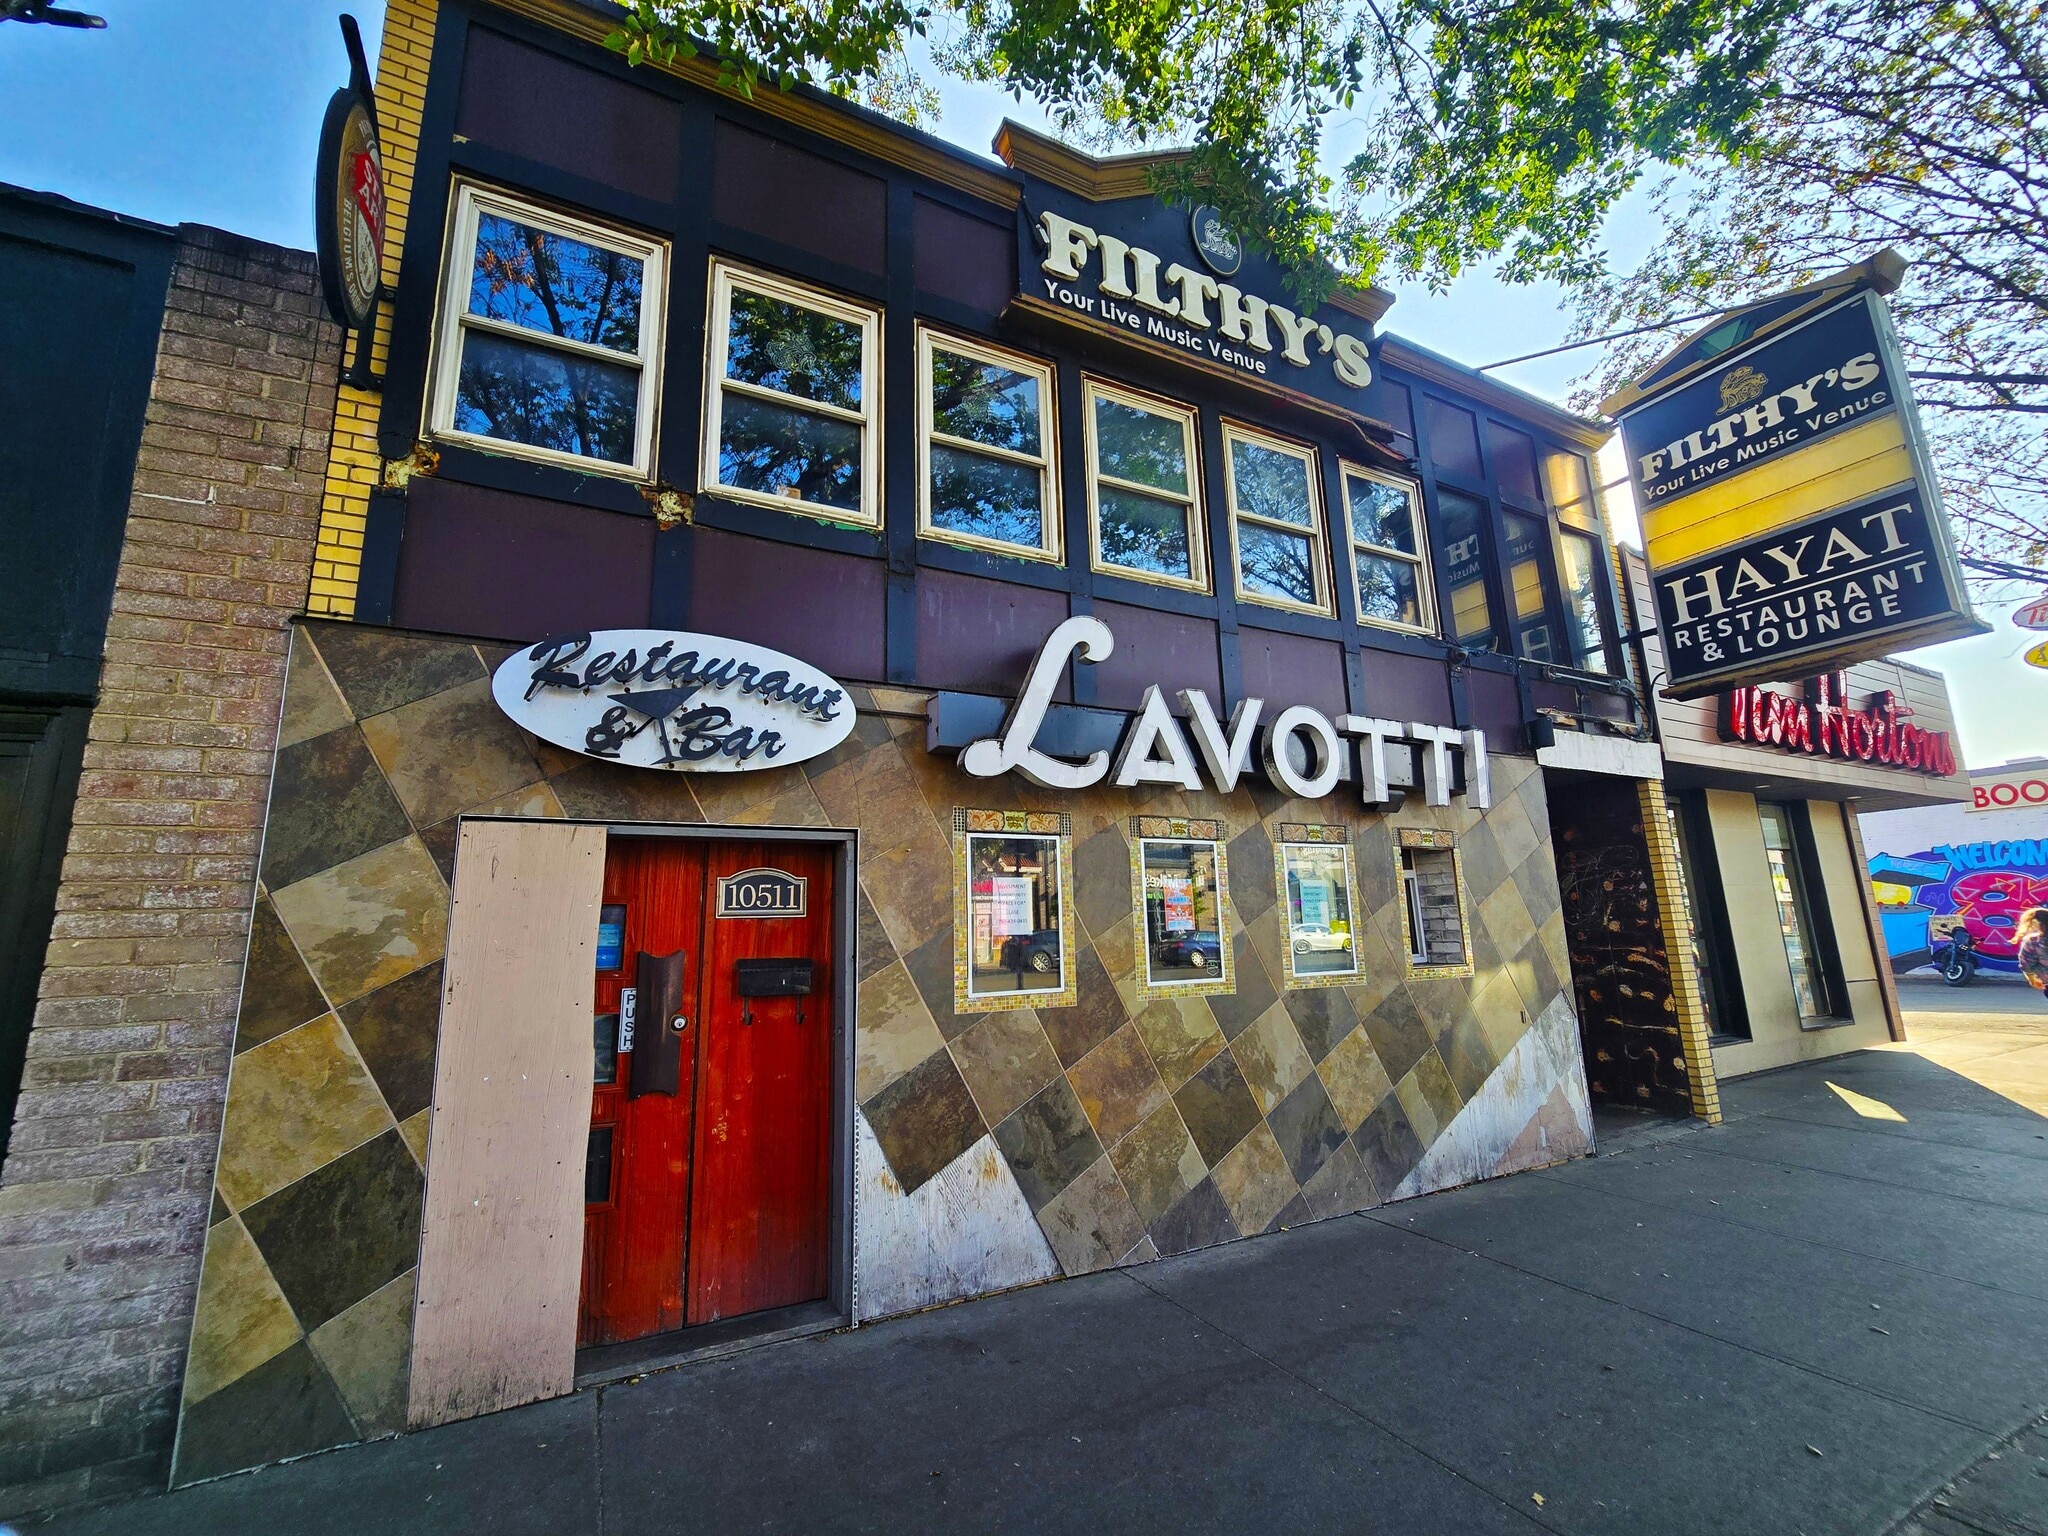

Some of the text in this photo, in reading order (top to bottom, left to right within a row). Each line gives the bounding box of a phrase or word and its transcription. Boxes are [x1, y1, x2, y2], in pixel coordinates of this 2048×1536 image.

[1039, 210, 1373, 388] FILTHY'S
[1044, 278, 1266, 374] Your Live Music Venue
[1638, 351, 1880, 482] FILTHY'S
[1644, 391, 1887, 500] Your Live Music Venue
[1664, 502, 1913, 627] HAYAT
[1674, 560, 1928, 649] RESTAURANT
[1703, 593, 1902, 663] & LOUNGE
[524, 630, 842, 721] Restaurant
[957, 615, 1491, 810] LAVOTTI
[584, 704, 786, 761] & Bar
[727, 884, 798, 909] 10511
[622, 993, 636, 1047] PUSH
